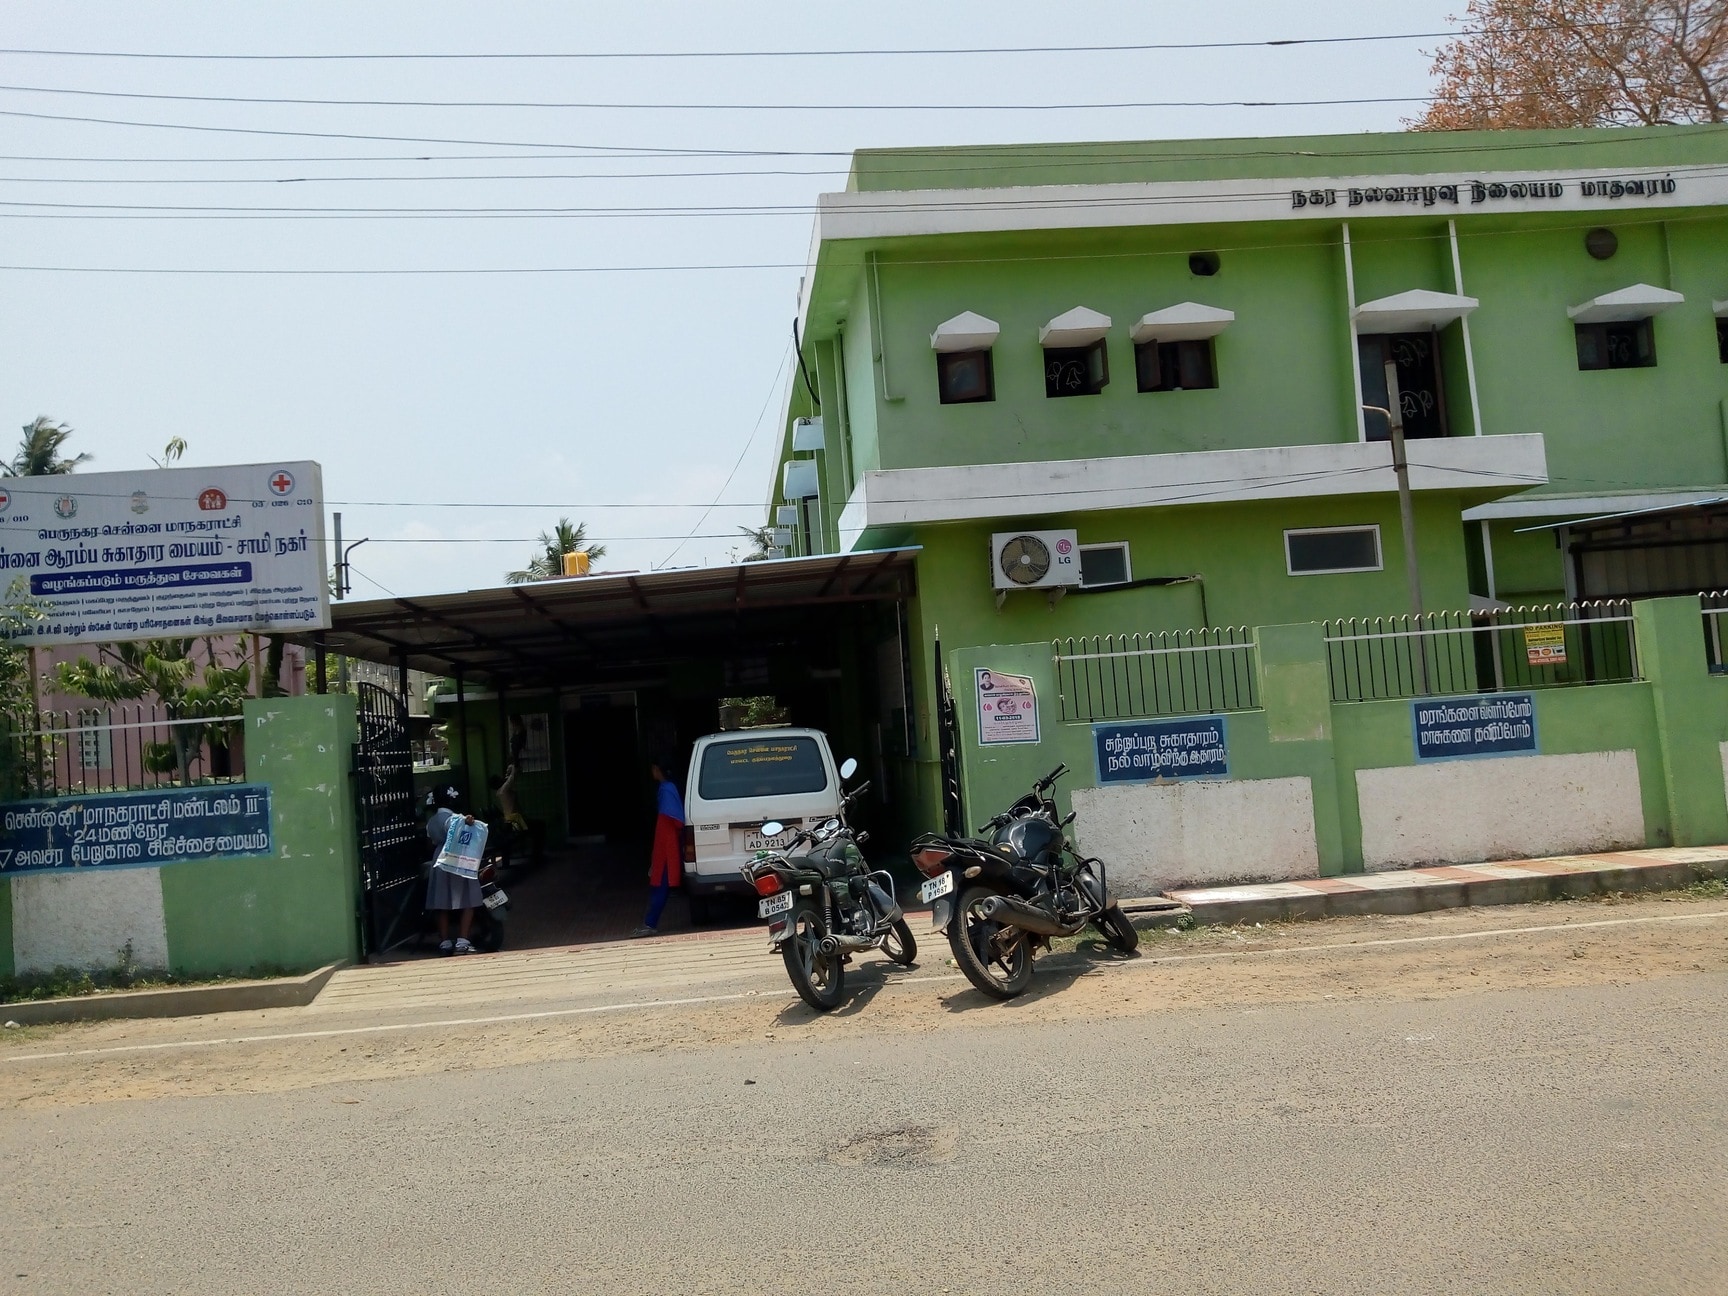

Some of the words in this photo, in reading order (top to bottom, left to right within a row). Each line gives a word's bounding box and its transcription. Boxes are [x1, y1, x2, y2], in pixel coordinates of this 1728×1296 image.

[1580, 173, 1676, 199] மாதவரம்
[102, 520, 162, 536] சென்னை
[165, 515, 242, 534] மாநகராட்சி
[44, 542, 98, 569] ஆரம்ப
[102, 544, 165, 566] சுகாதார
[168, 534, 223, 559] மையம்
[236, 532, 271, 555] சாமி
[275, 528, 308, 557] நகர்
[1058, 556, 1071, 564] LG
[42, 573, 122, 592] வழங்கப்படும்
[124, 569, 180, 587] மருத்துவ
[182, 566, 242, 582] சேவைகள்
[1420, 704, 1480, 727] மரங்களை
[1480, 698, 1532, 720] வளர்ப்போம்
[1105, 732, 1157, 754] சுற்றுப்புற
[1160, 726, 1219, 749] சுகாதாரம்
[1421, 727, 1472, 745] மாசுகளை
[1474, 720, 1531, 744] தவிர்ப்போம்
[1108, 752, 1131, 772] நல்
[5, 808, 76, 830] சென்னை
[83, 800, 171, 826] மாநகராட்சி
[173, 794, 241, 819] மண்டலம்
[14, 848, 64, 867] அவசர
[71, 843, 141, 865] பேறுகால
[750, 840, 762, 848] AD
[764, 838, 785, 848] 9213
[928, 880, 937, 890] TN
[928, 892, 932, 900] P
[766, 898, 776, 906] TN
